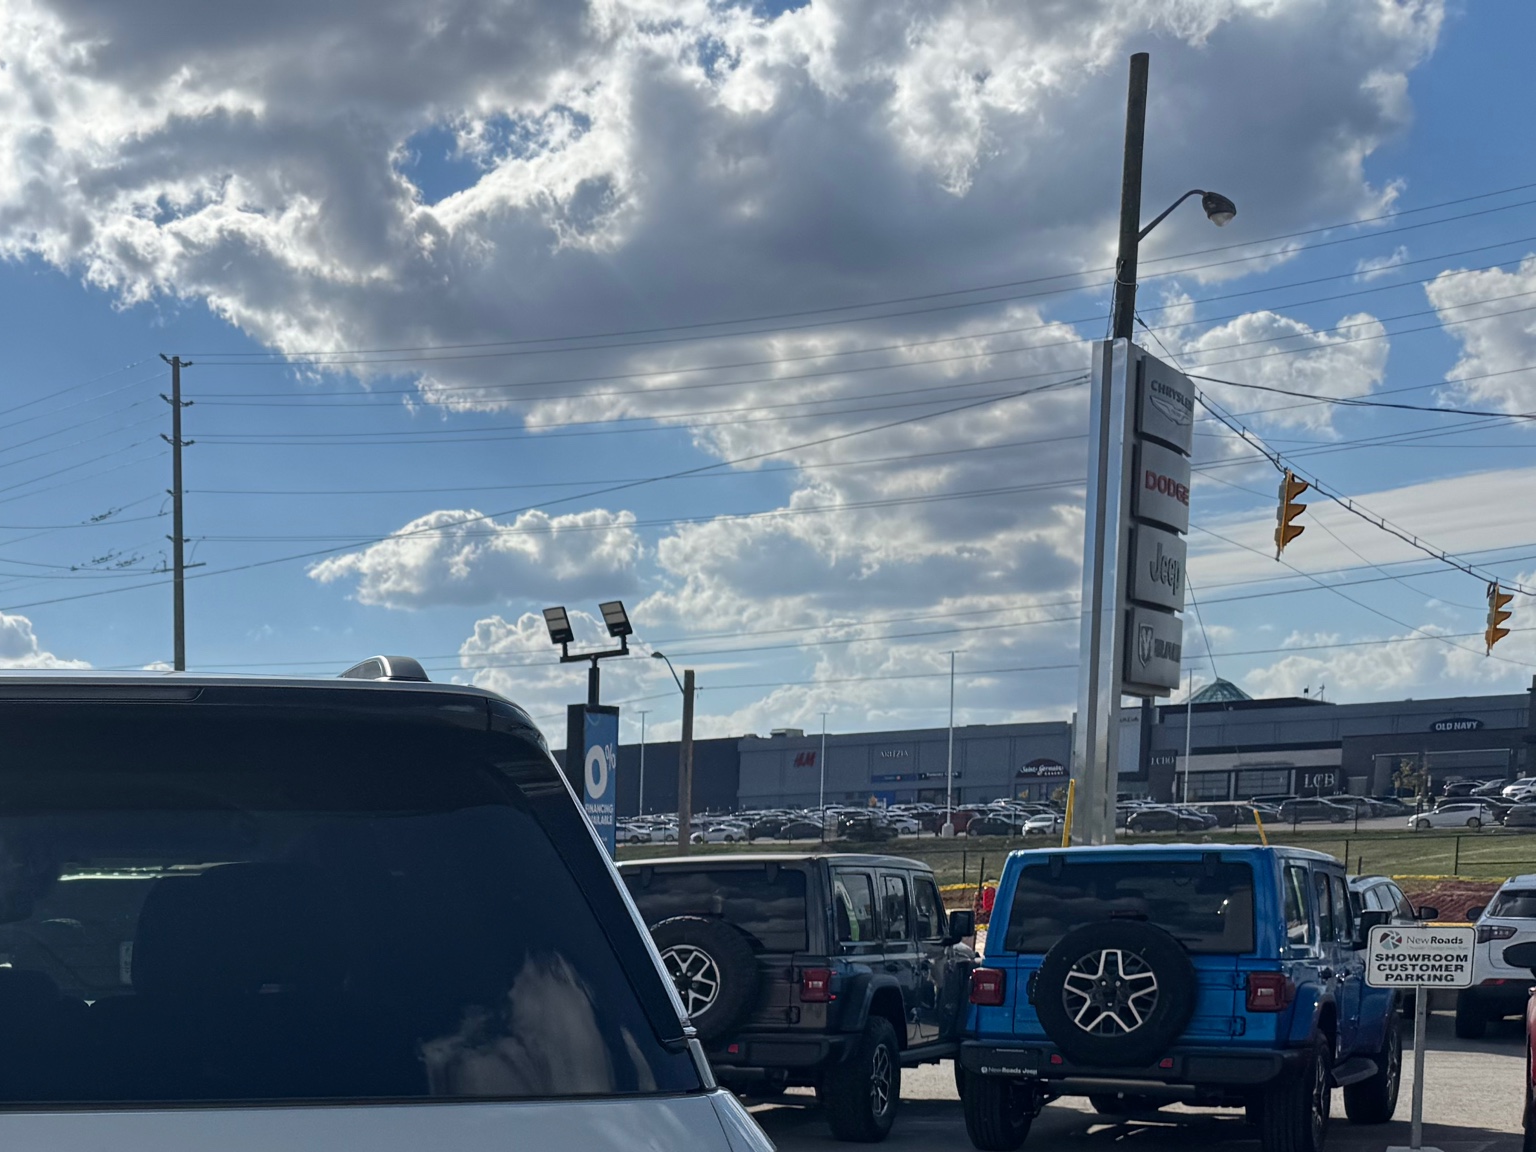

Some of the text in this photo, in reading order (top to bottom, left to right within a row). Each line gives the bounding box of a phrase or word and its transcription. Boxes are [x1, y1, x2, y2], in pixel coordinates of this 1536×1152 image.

[1145, 469, 1190, 507] DODGE
[1149, 542, 1180, 596] Jeep
[1435, 720, 1478, 731] OLD NAVY
[1375, 953, 1468, 962] SHOWROOM
[1377, 963, 1464, 972] CUSTOMER
[1384, 973, 1456, 982] PARKING
